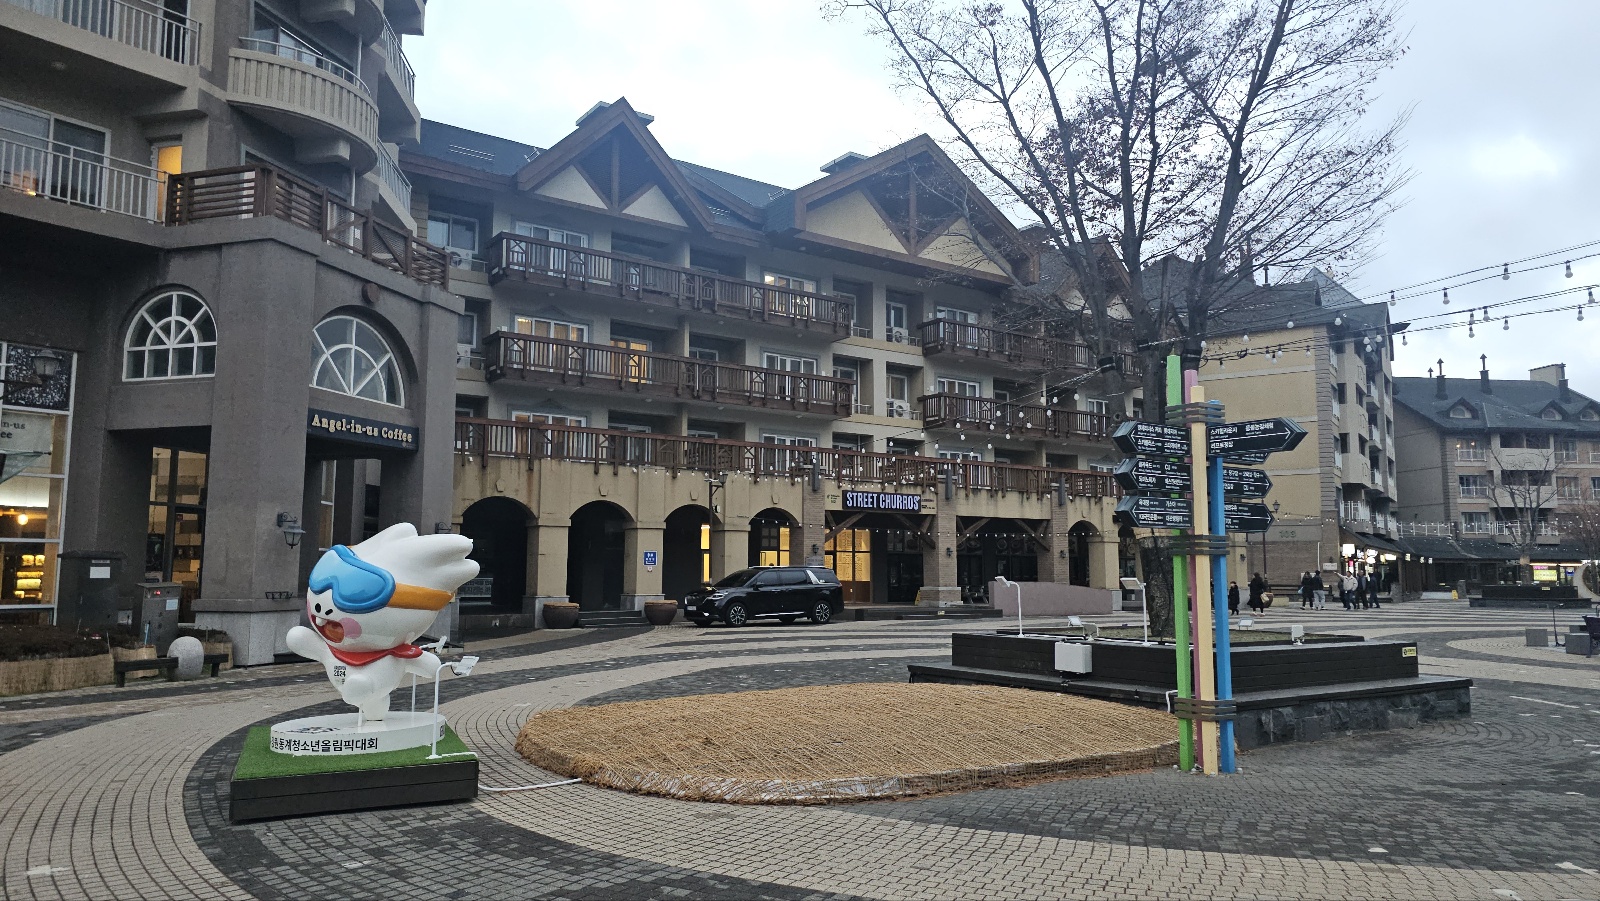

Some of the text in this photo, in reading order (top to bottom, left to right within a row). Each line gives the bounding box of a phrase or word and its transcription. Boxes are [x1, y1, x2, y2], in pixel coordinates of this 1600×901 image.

[312, 414, 412, 442] Angel-in-us Coffee
[846, 491, 878, 509] STREET
[879, 493, 920, 511] CHURROS
